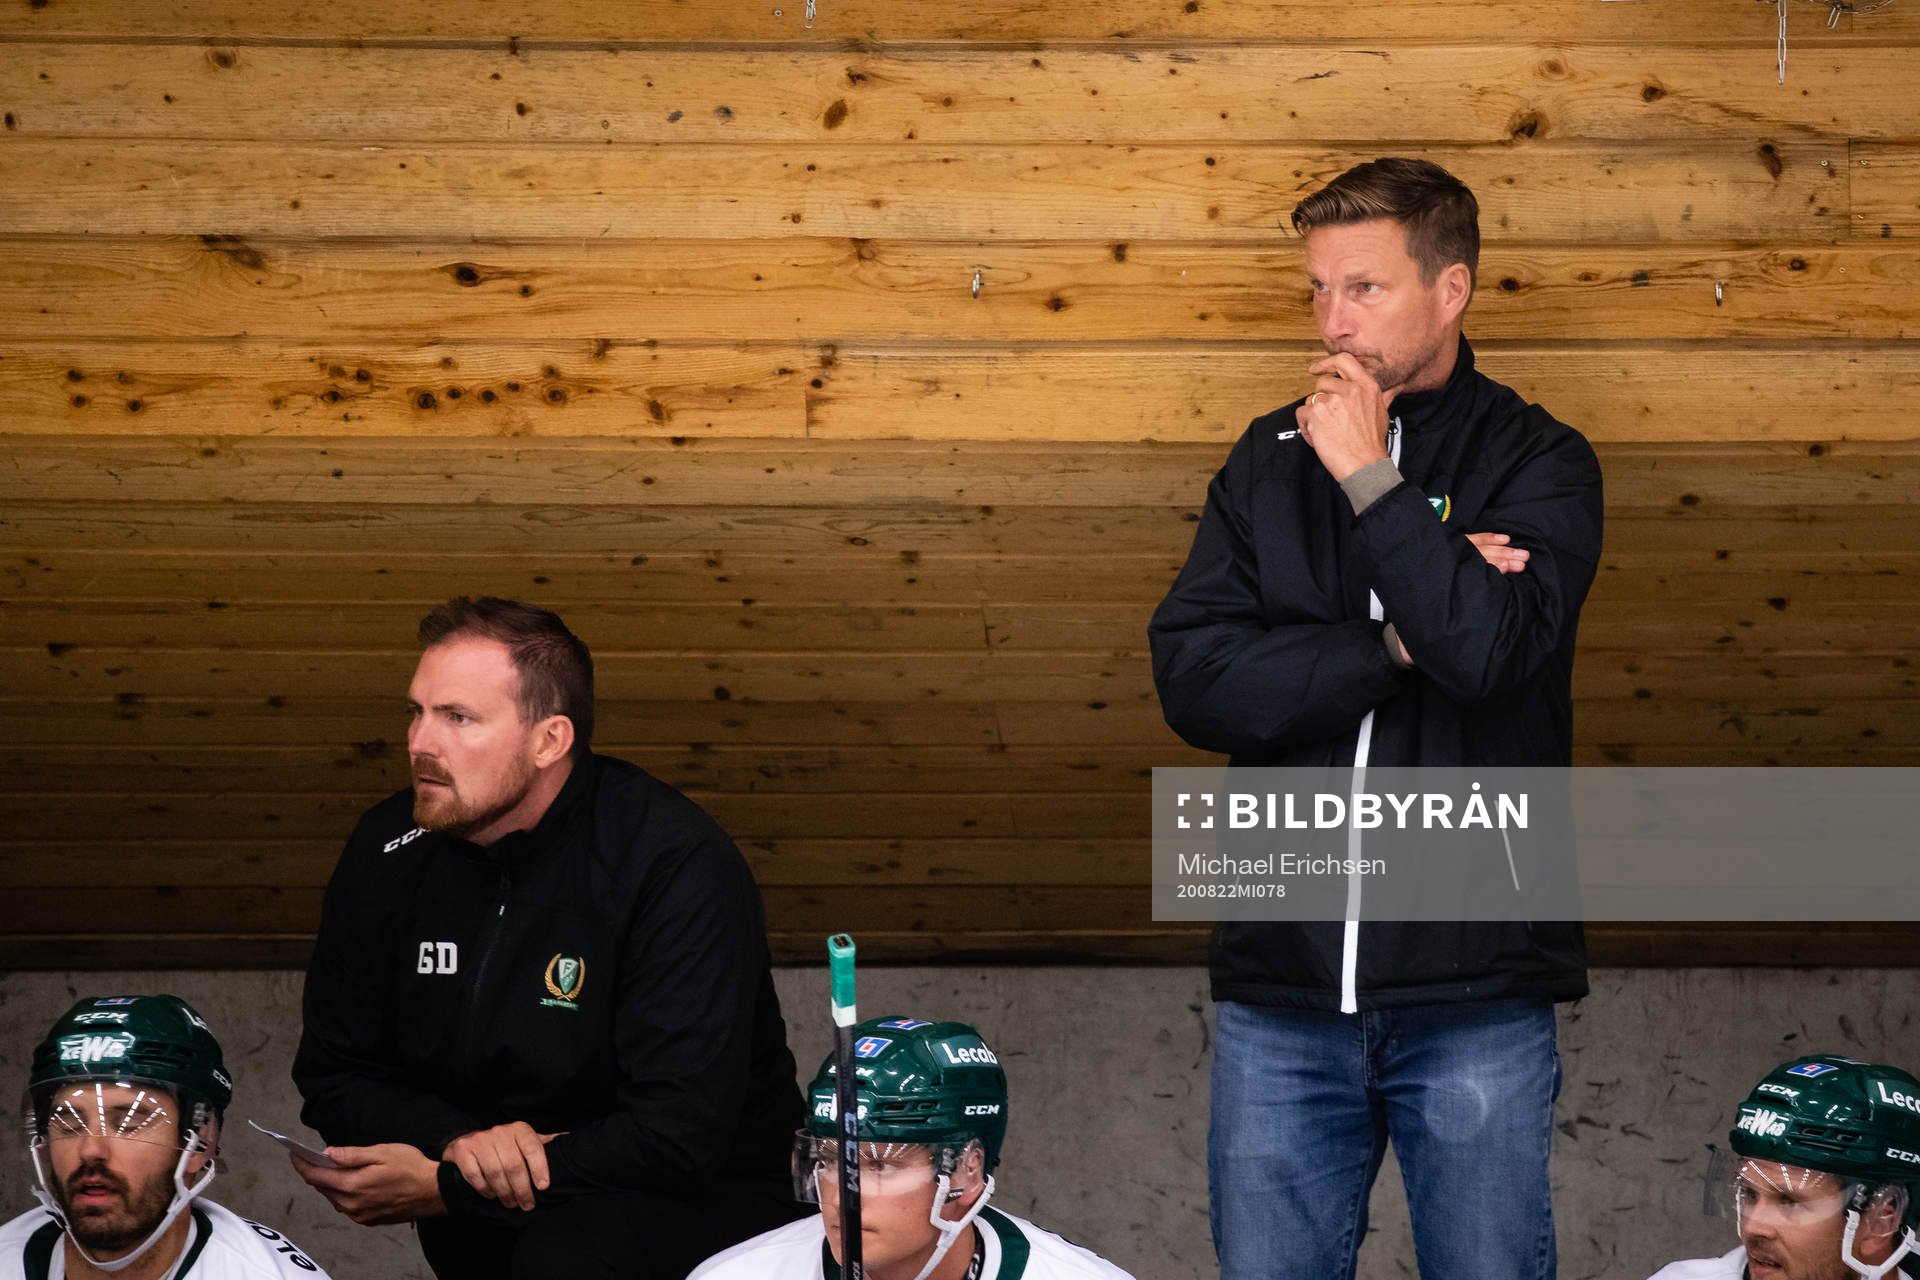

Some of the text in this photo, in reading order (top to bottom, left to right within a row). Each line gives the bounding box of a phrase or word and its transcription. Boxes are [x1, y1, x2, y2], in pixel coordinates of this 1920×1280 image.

[73, 1012, 129, 1022] CCM
[941, 1041, 998, 1065] Lecab
[1757, 1083, 1801, 1098] CCM
[964, 1104, 1000, 1115] CCM
[844, 1110, 860, 1193] CCM
